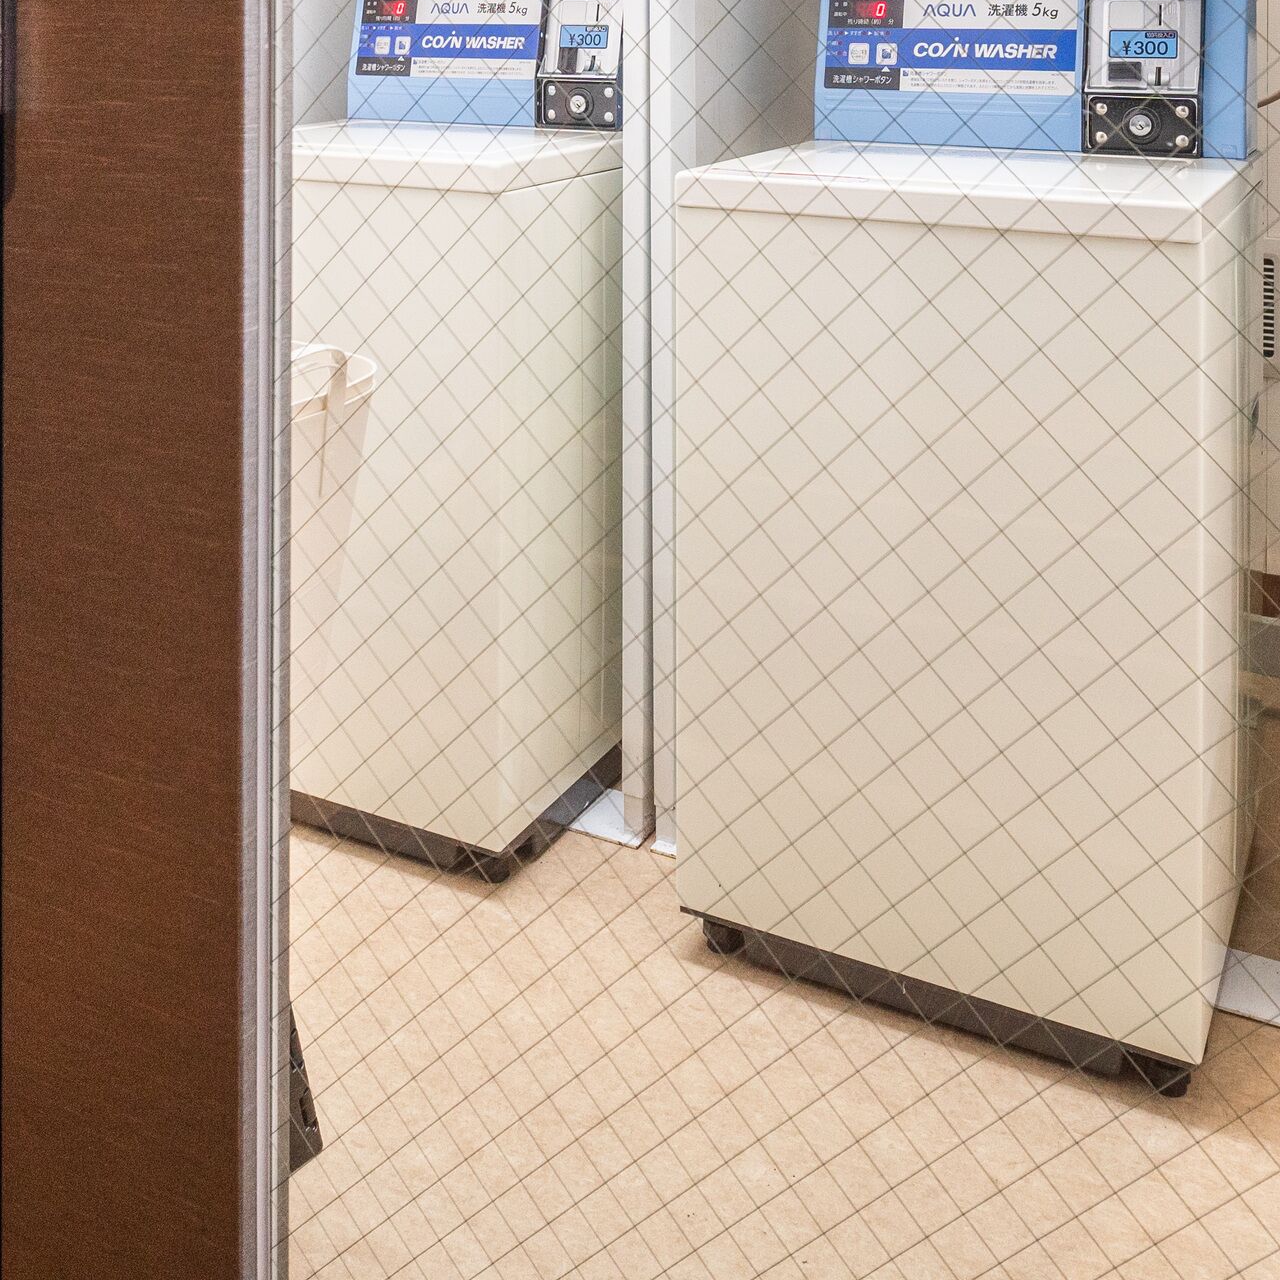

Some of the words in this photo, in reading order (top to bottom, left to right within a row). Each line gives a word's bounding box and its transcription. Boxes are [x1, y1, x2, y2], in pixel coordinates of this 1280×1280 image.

[430, 1, 470, 15] AQUA
[477, 1, 506, 15] 洗濯機
[508, 1, 528, 17] 5kg
[876, 3, 885, 17] 0
[922, 3, 977, 18] AQUA
[987, 3, 1029, 18] 洗濯機
[1031, 1, 1060, 20] 5kg
[421, 30, 462, 49] COIN
[465, 36, 526, 50] WASHER
[568, 33, 601, 46] ¥300
[912, 36, 970, 59] COIN
[974, 43, 1059, 60] WASHER
[1122, 40, 1169, 56] ¥300
